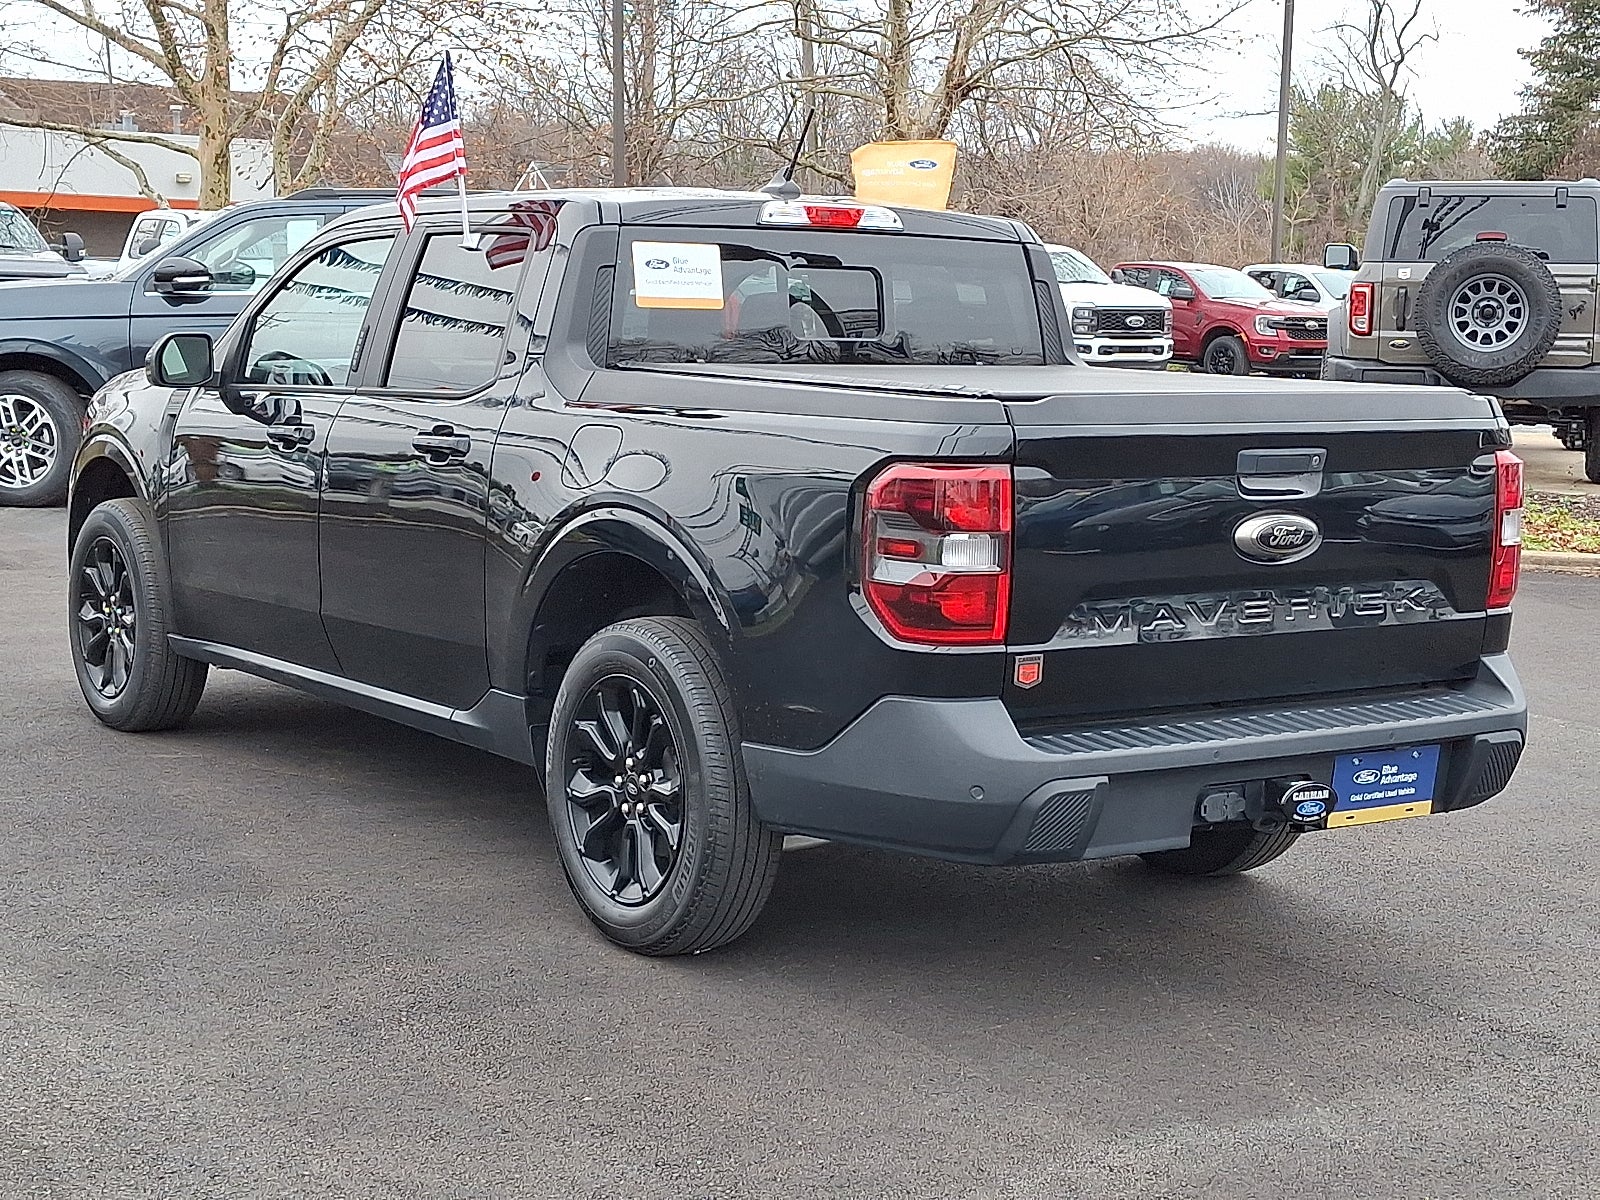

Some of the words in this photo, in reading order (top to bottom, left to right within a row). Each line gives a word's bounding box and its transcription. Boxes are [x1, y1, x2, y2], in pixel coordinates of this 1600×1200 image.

[673, 266, 712, 275] Advantage
[1270, 525, 1305, 546] Ford
[1087, 587, 1426, 636] MAVERICK
[1382, 765, 1398, 774] Blue
[1380, 773, 1417, 785] Advantage
[1292, 790, 1329, 801] CARMAN
[1350, 794, 1363, 802] Gold
[1363, 791, 1384, 801] Certified
[1300, 802, 1322, 814] Ford
